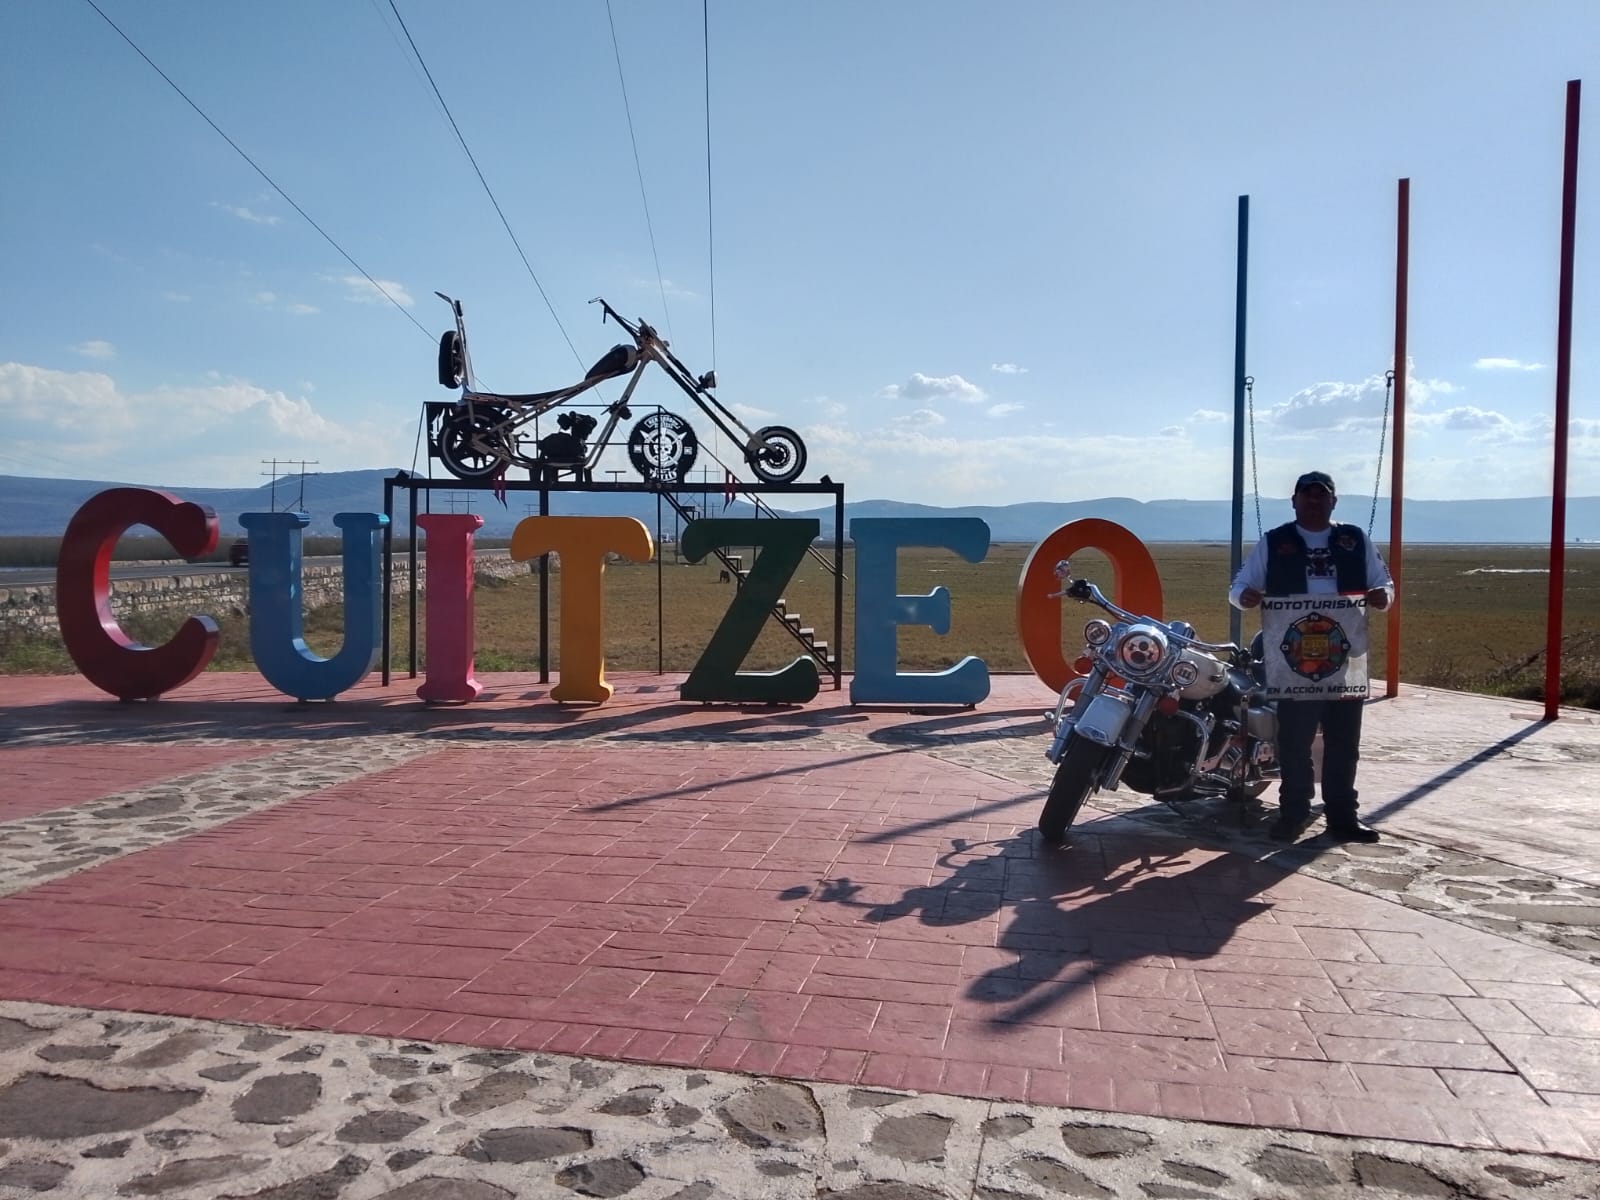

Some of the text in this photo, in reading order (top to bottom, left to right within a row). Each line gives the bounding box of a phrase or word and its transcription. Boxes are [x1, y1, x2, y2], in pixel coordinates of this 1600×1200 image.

[57, 487, 1163, 706] CUITZEO
[1261, 598, 1368, 610] MOTOTURISMO
[1267, 687, 1281, 695] EN
[1285, 684, 1324, 695] ACCIÓN
